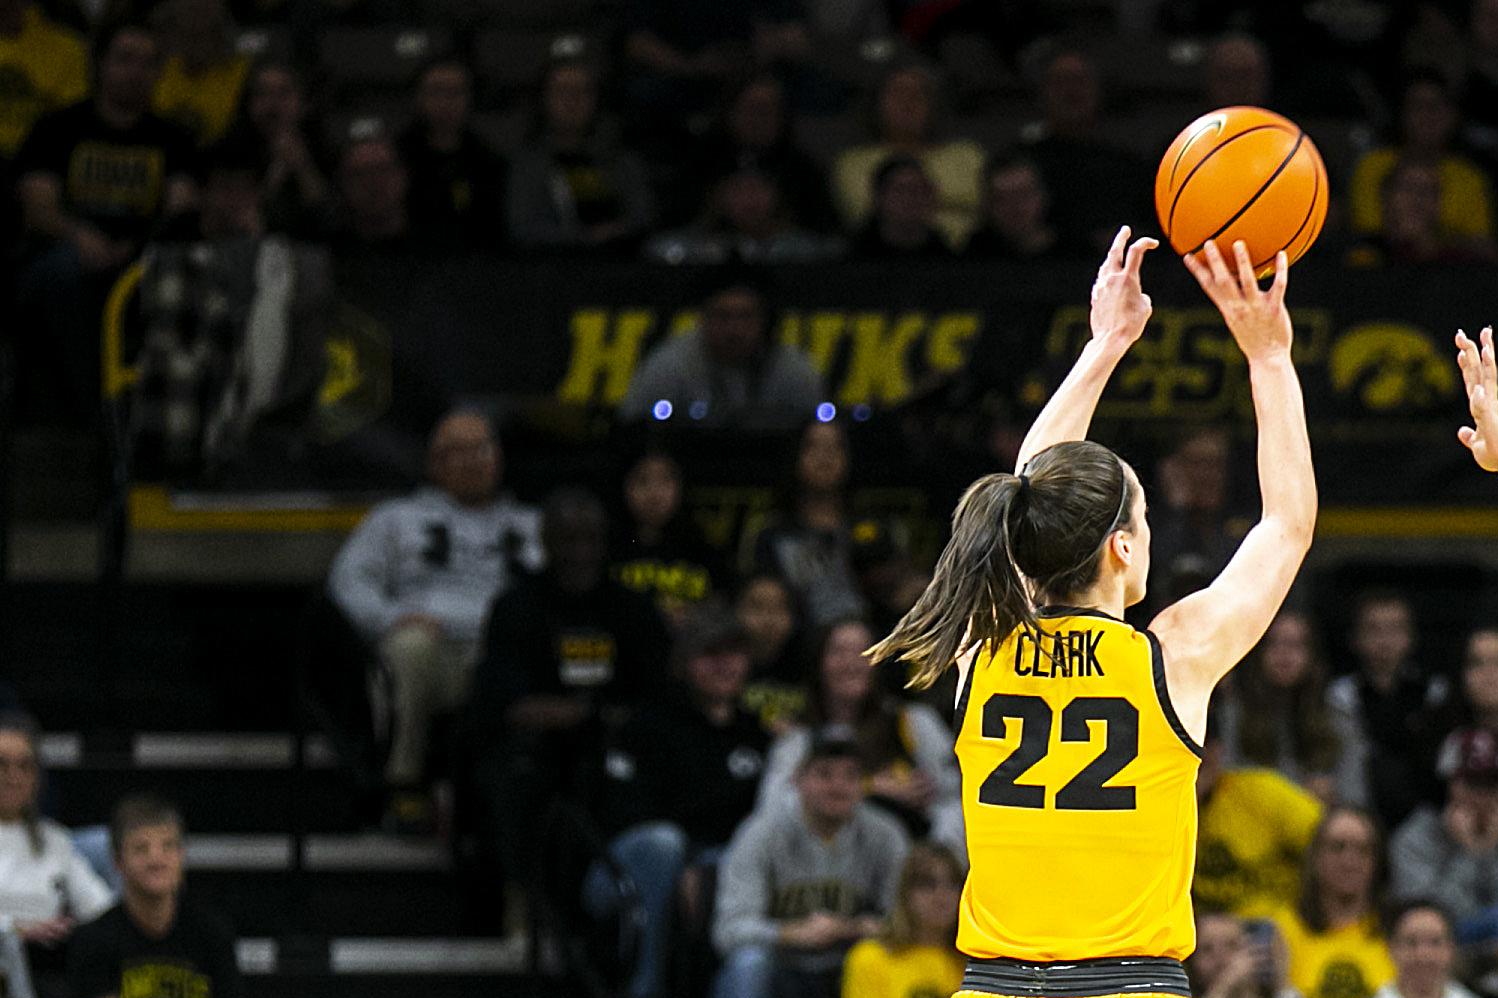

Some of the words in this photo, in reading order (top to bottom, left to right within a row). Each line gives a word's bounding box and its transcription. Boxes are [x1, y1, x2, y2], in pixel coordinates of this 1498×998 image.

[558, 309, 980, 404] HKS
[1015, 629, 1105, 678] CLARK
[979, 693, 1139, 810] 22
